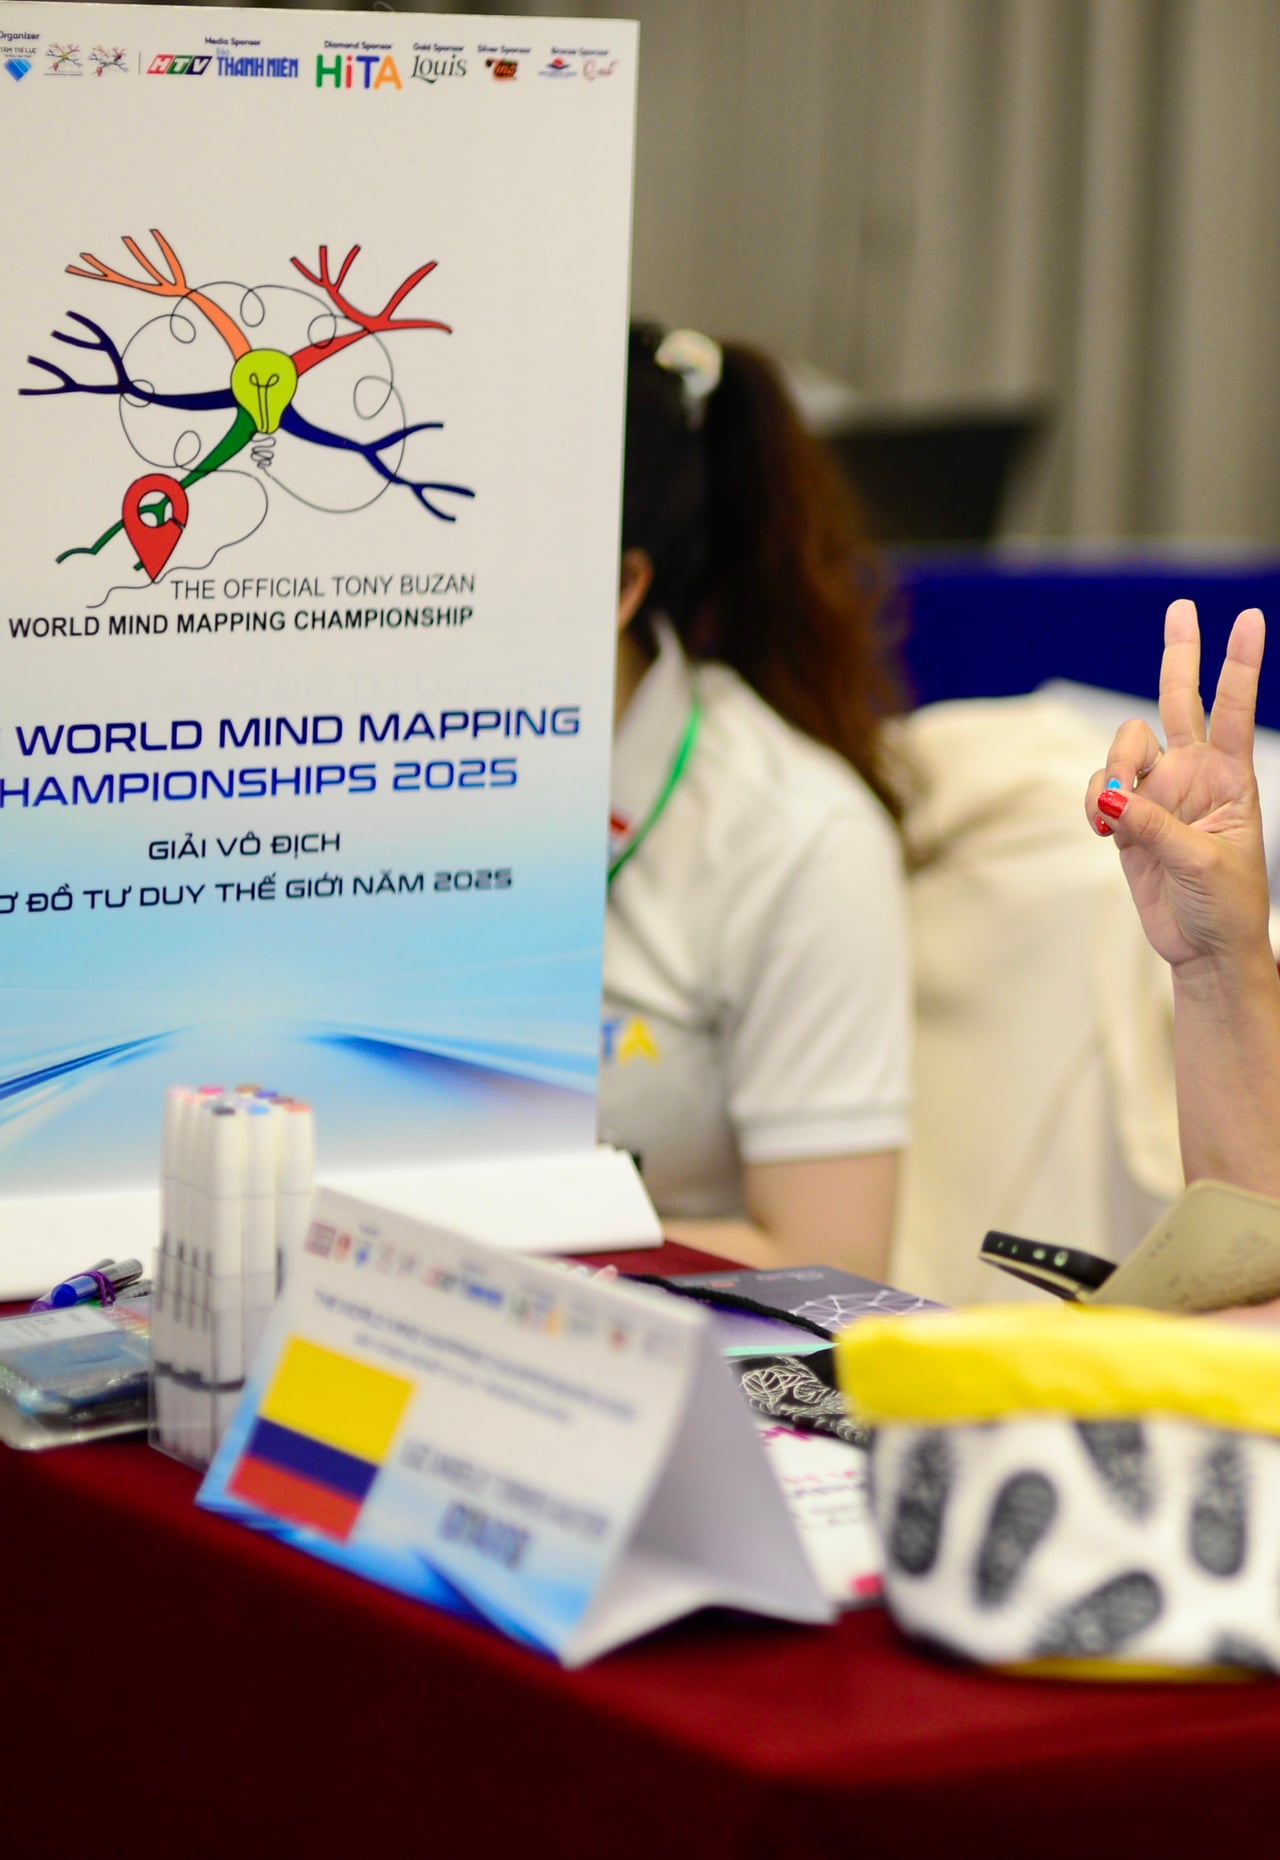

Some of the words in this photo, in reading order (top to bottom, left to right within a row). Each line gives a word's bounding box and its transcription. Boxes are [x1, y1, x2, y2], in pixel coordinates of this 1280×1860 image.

[230, 37, 261, 47] Sponsor
[148, 55, 211, 75] HTV
[410, 54, 467, 84] Louis
[170, 579, 215, 600] THE
[223, 577, 326, 599] OFFICIAL
[332, 575, 394, 597] TONY
[400, 573, 476, 596] BUZAN
[8, 616, 100, 638] WORLD
[108, 614, 169, 636] MIND
[177, 610, 286, 634] MAPPING
[294, 606, 474, 631] CHAMPIONSHIP
[15, 719, 203, 757] WORLD
[219, 715, 343, 749] MIND
[358, 706, 581, 744] MAPPING
[0, 762, 378, 808] HAMPIONSHIPS
[392, 757, 518, 792] 2025
[148, 832, 207, 860] GIẢI
[216, 830, 261, 858] VÔ
[270, 832, 341, 860] ĐỊCH
[0, 891, 19, 914] Ơ
[26, 883, 74, 914] ĐỒ
[83, 884, 132, 910] TƯ
[139, 884, 206, 907] DUY
[215, 872, 277, 903] THẾ
[286, 871, 344, 900] GIỚI
[352, 868, 425, 896] NĂM
[433, 867, 512, 893] 2025
[600, 1014, 661, 1068] TA
